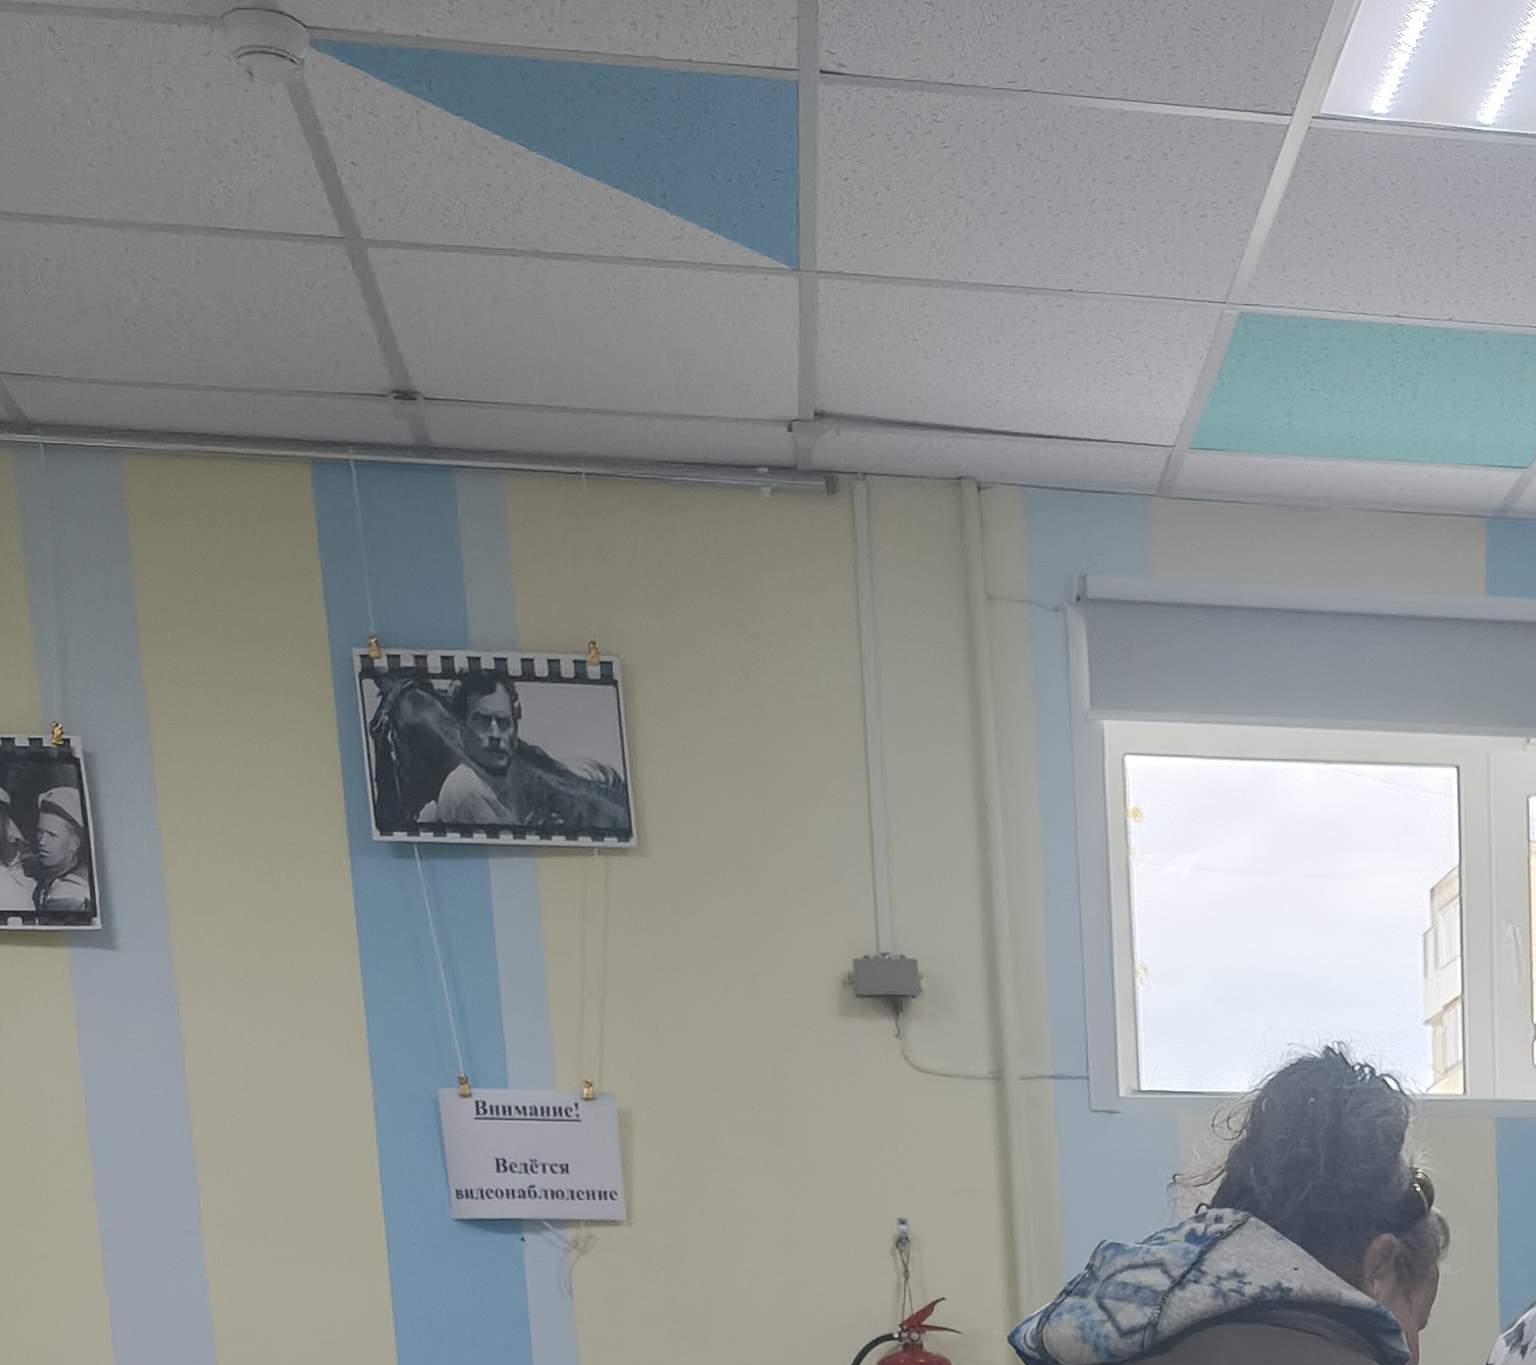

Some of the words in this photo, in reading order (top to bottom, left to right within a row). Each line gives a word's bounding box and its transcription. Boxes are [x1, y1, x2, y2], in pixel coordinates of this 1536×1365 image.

[474, 1099, 581, 1121] Внимание!
[494, 1156, 570, 1175] Ведётся
[454, 1184, 618, 1202] видеонаблюдение
